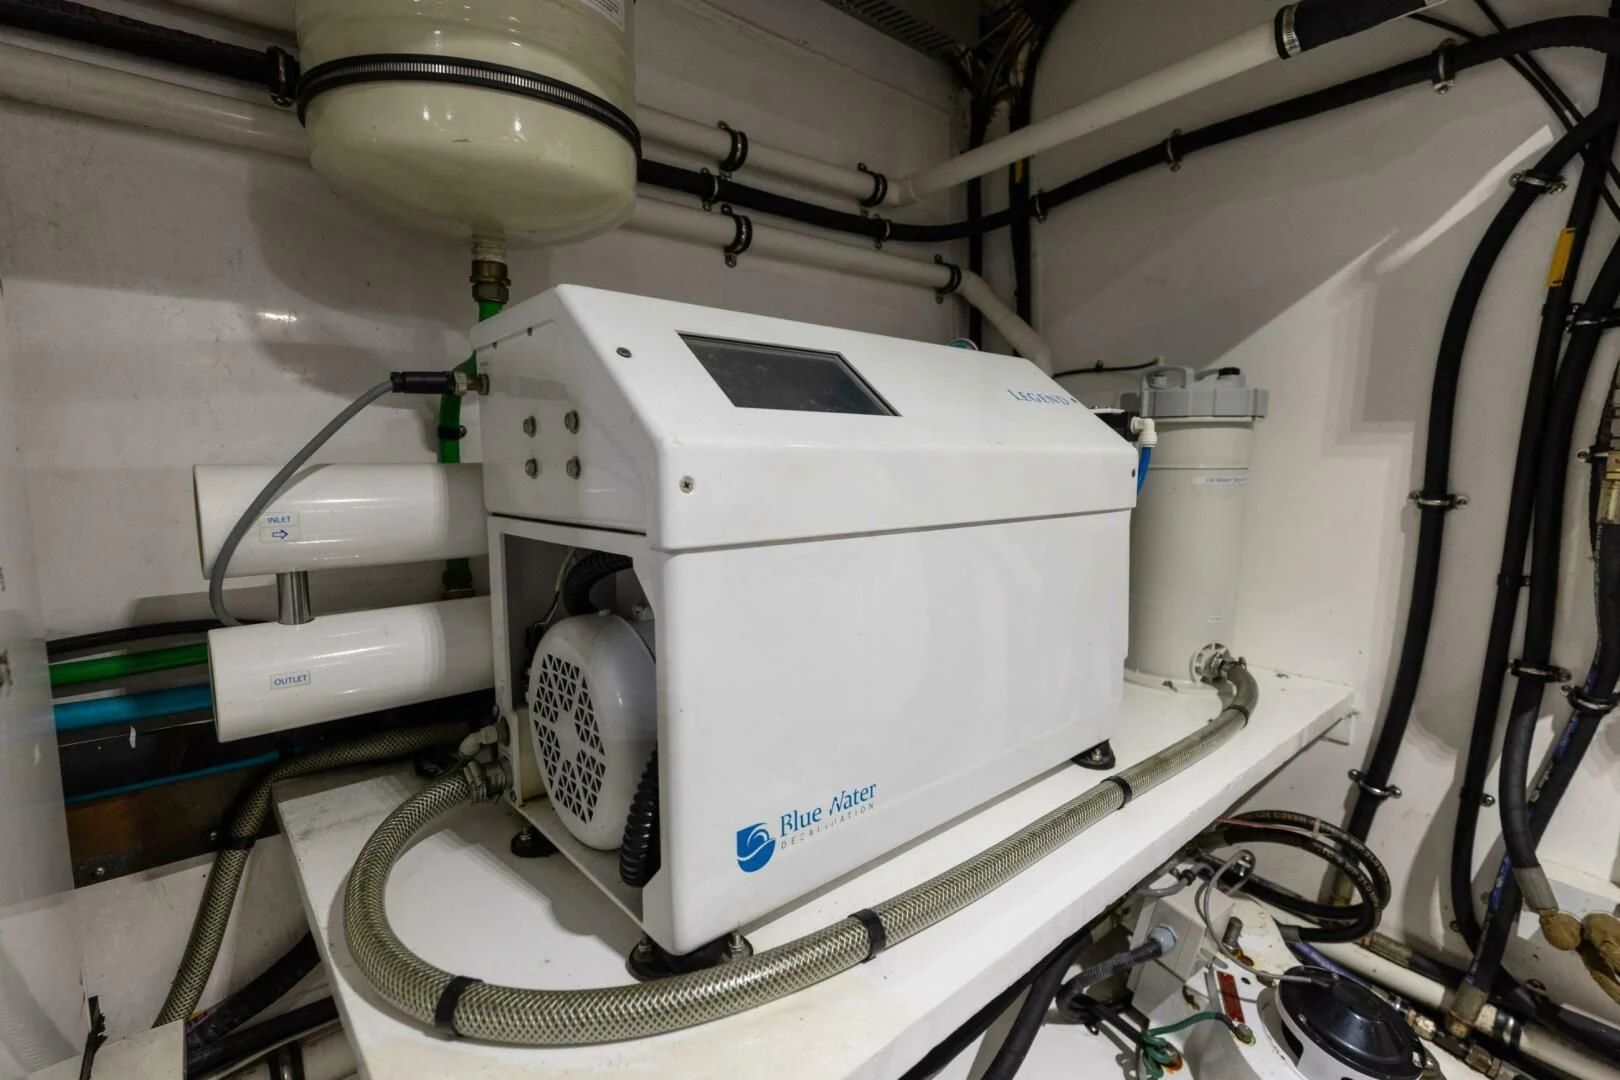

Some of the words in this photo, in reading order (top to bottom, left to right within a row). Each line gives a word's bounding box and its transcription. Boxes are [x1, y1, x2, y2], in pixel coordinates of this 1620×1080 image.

[1007, 389, 1070, 405] LEGEND
[267, 515, 291, 523] INLET
[274, 674, 307, 686] OUTLET
[780, 807, 822, 838] Blue
[829, 783, 877, 817] Water
